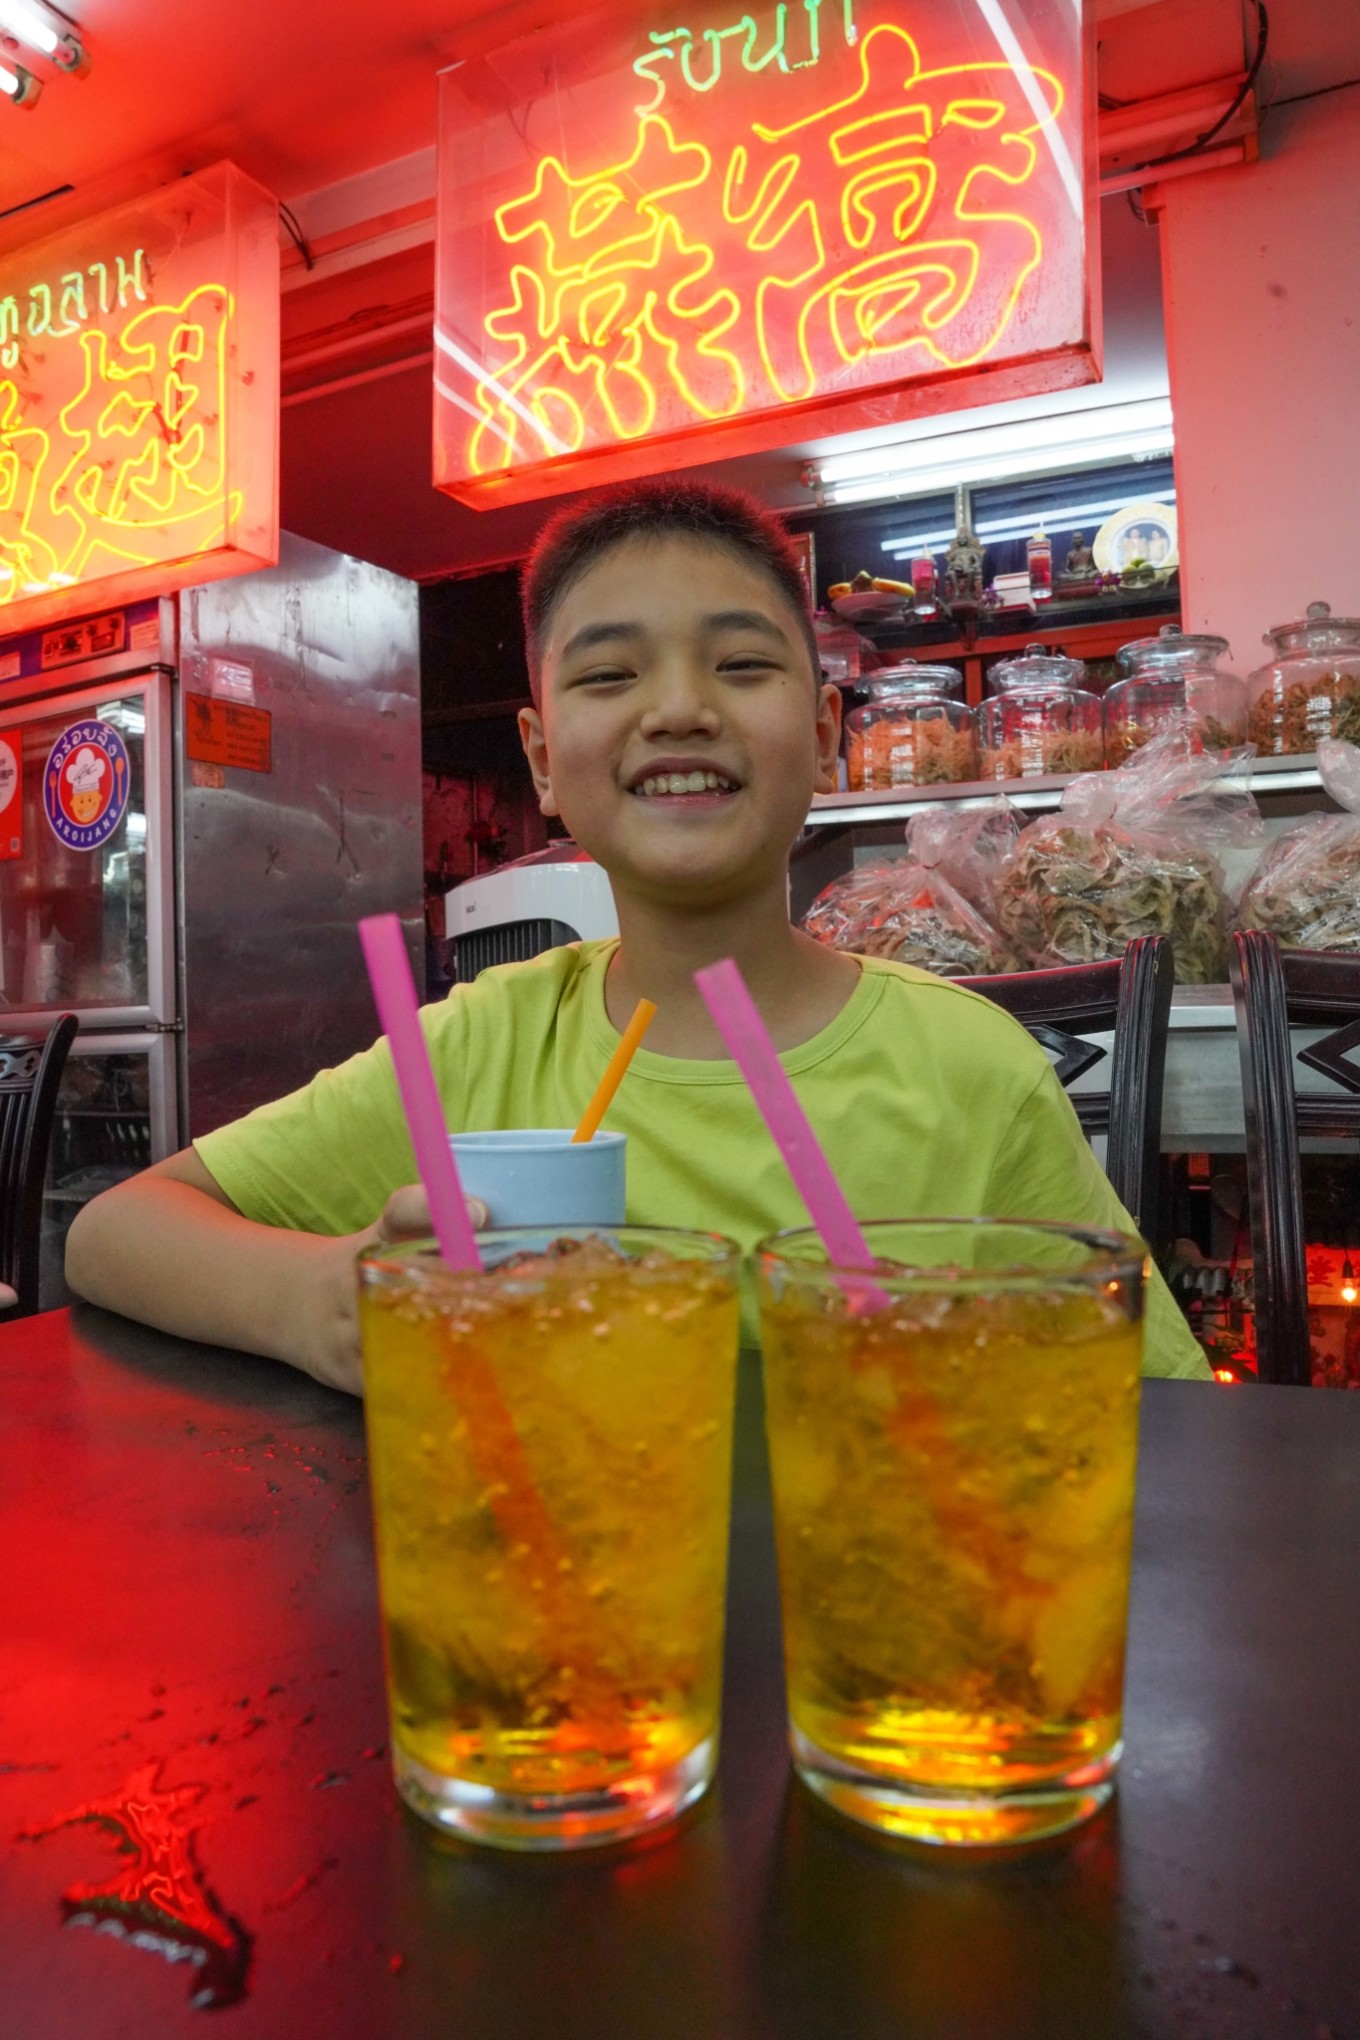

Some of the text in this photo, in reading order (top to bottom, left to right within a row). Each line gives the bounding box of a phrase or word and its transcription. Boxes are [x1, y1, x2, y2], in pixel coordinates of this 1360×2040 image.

[52, 726, 118, 769] อร่อยจัง
[56, 808, 117, 843] AROIJANG
